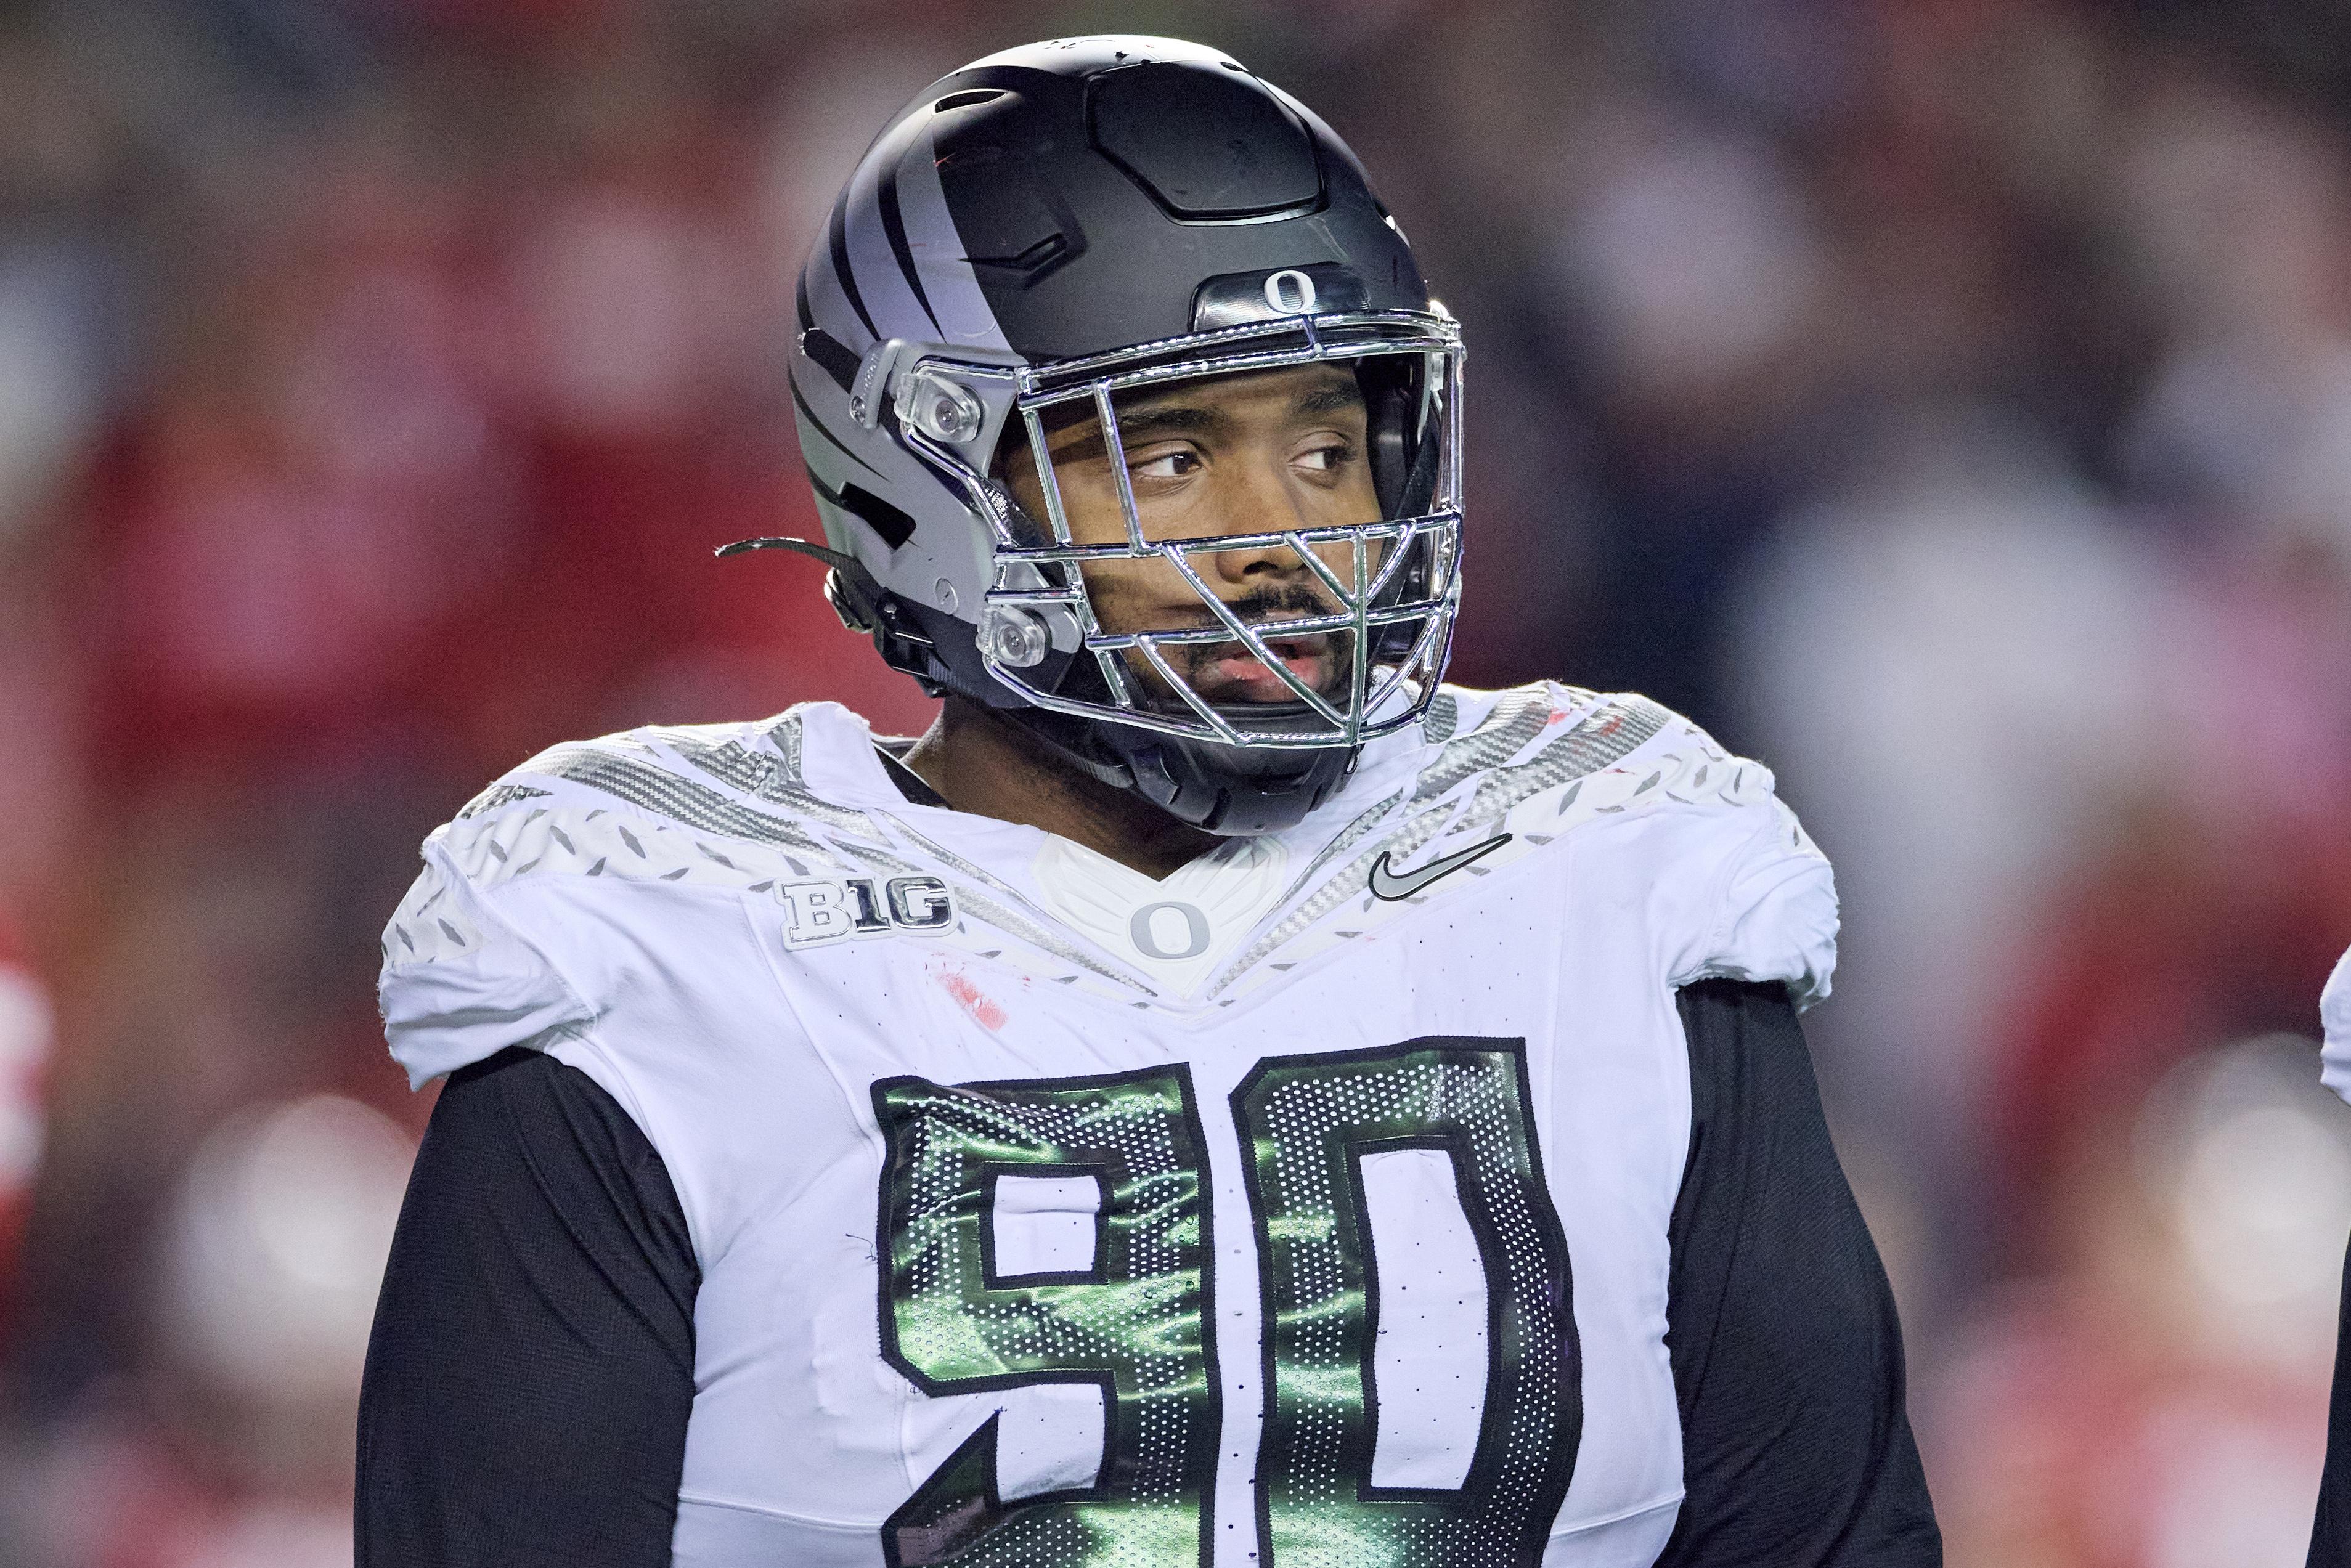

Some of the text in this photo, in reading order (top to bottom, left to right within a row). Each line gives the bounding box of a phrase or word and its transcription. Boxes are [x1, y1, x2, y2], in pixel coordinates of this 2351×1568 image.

[1263, 270, 1316, 314] O
[1130, 901, 1210, 959] O
[870, 1036, 1583, 1568] 90
